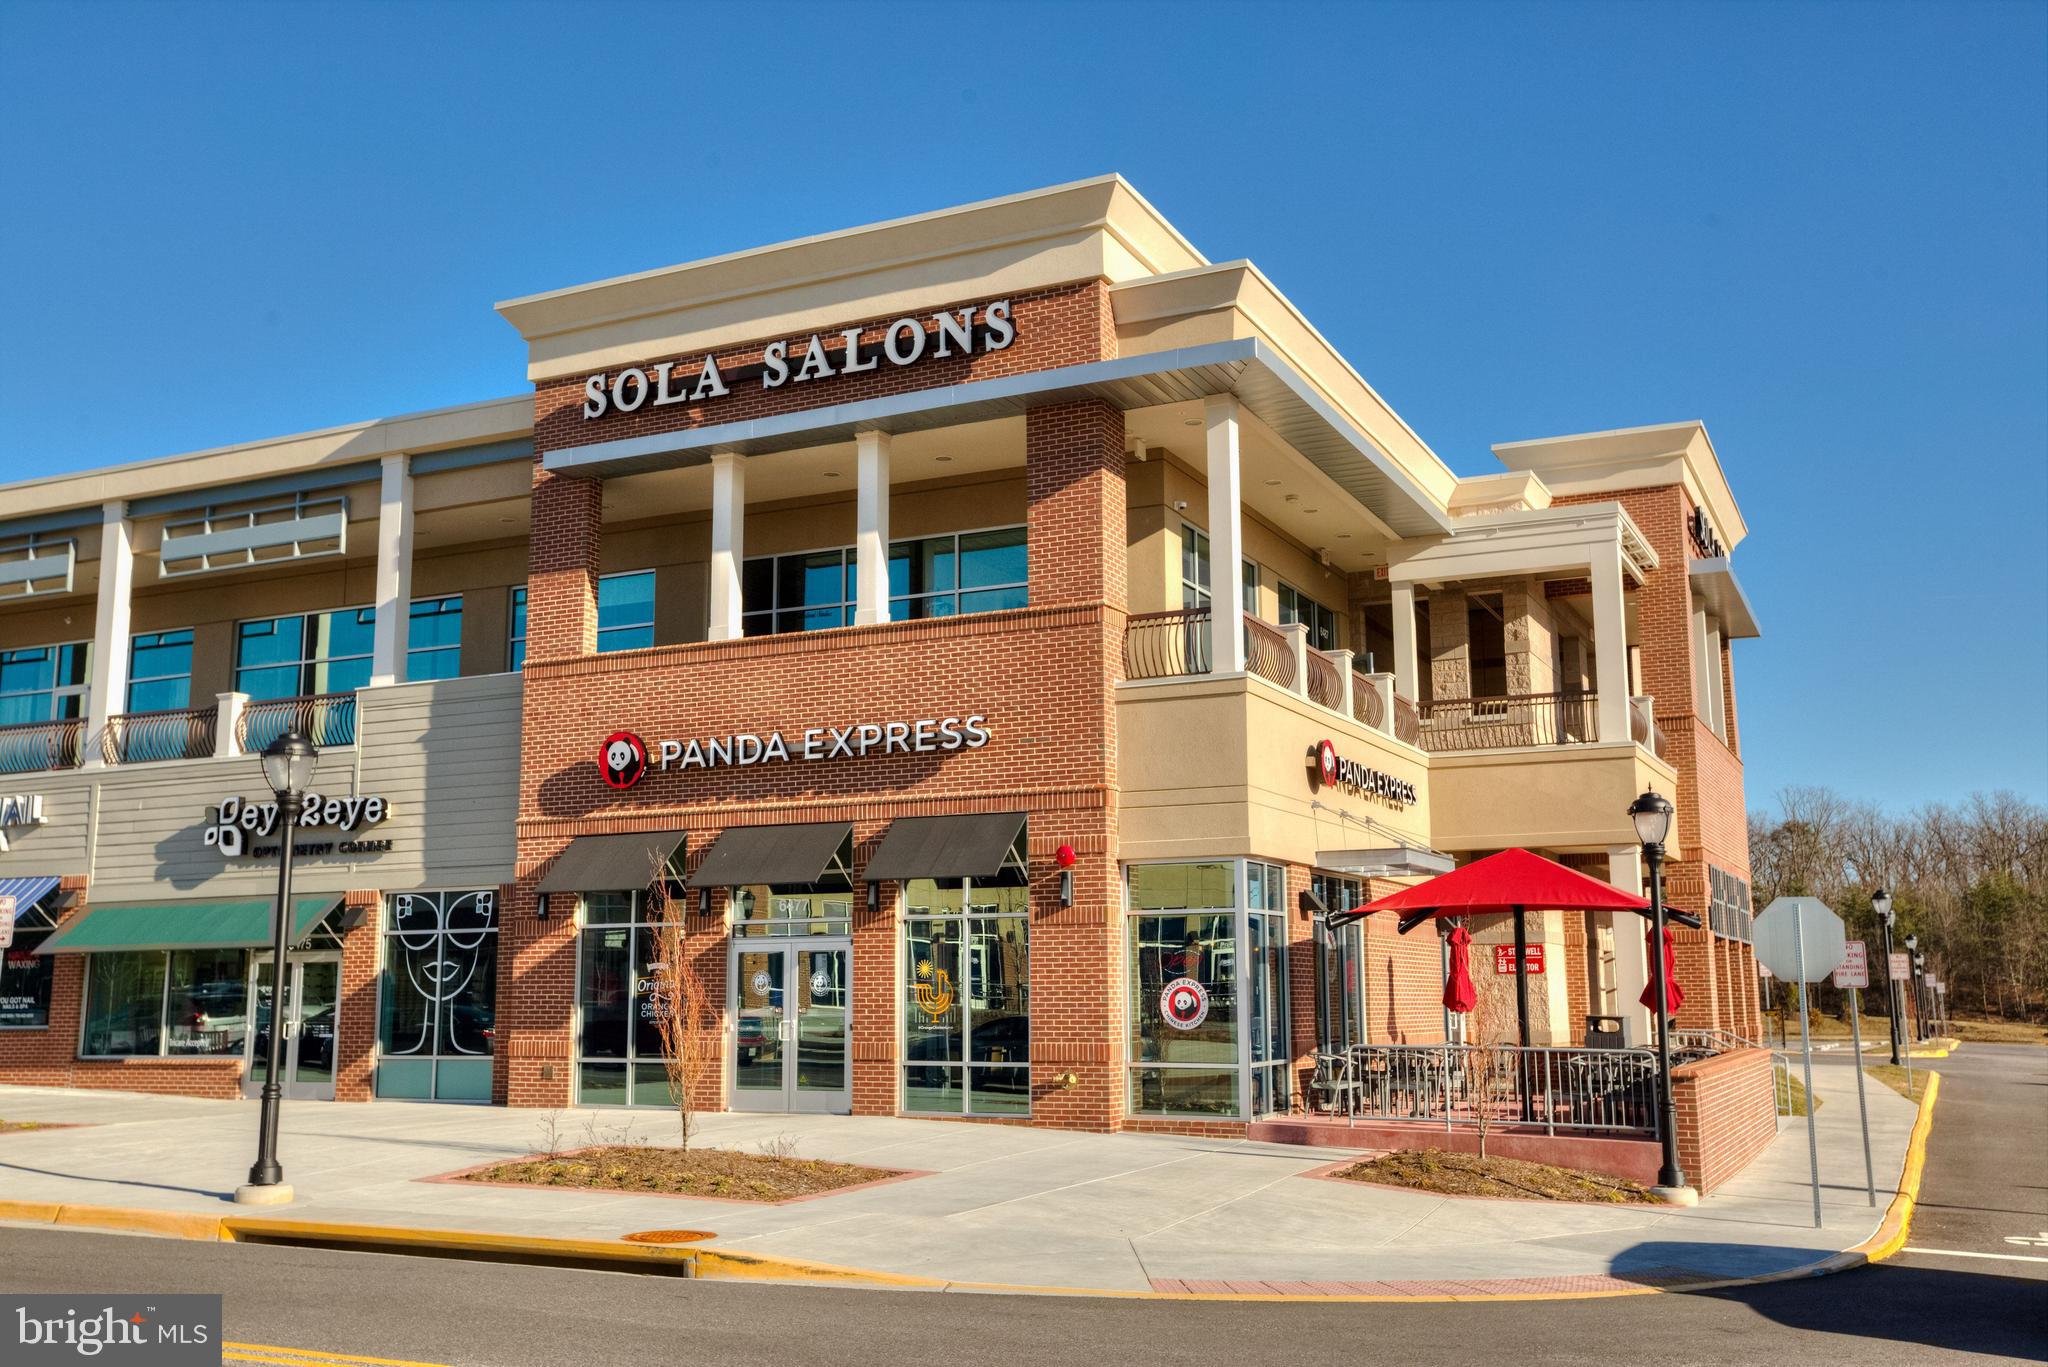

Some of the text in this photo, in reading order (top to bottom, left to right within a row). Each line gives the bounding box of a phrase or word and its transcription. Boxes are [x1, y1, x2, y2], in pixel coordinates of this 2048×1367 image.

[584, 299, 1016, 420] SOLA SALONS
[659, 715, 990, 771] PANDA EXPRESS
[1338, 756, 1417, 806] PANDA EXPRESS
[0, 795, 48, 827] AIL
[241, 793, 383, 837] ey2eye
[1507, 947, 1541, 956] STWELL
[1508, 963, 1539, 971] ELTOR
[1163, 979, 1207, 1002] PANDA EXPRESS
